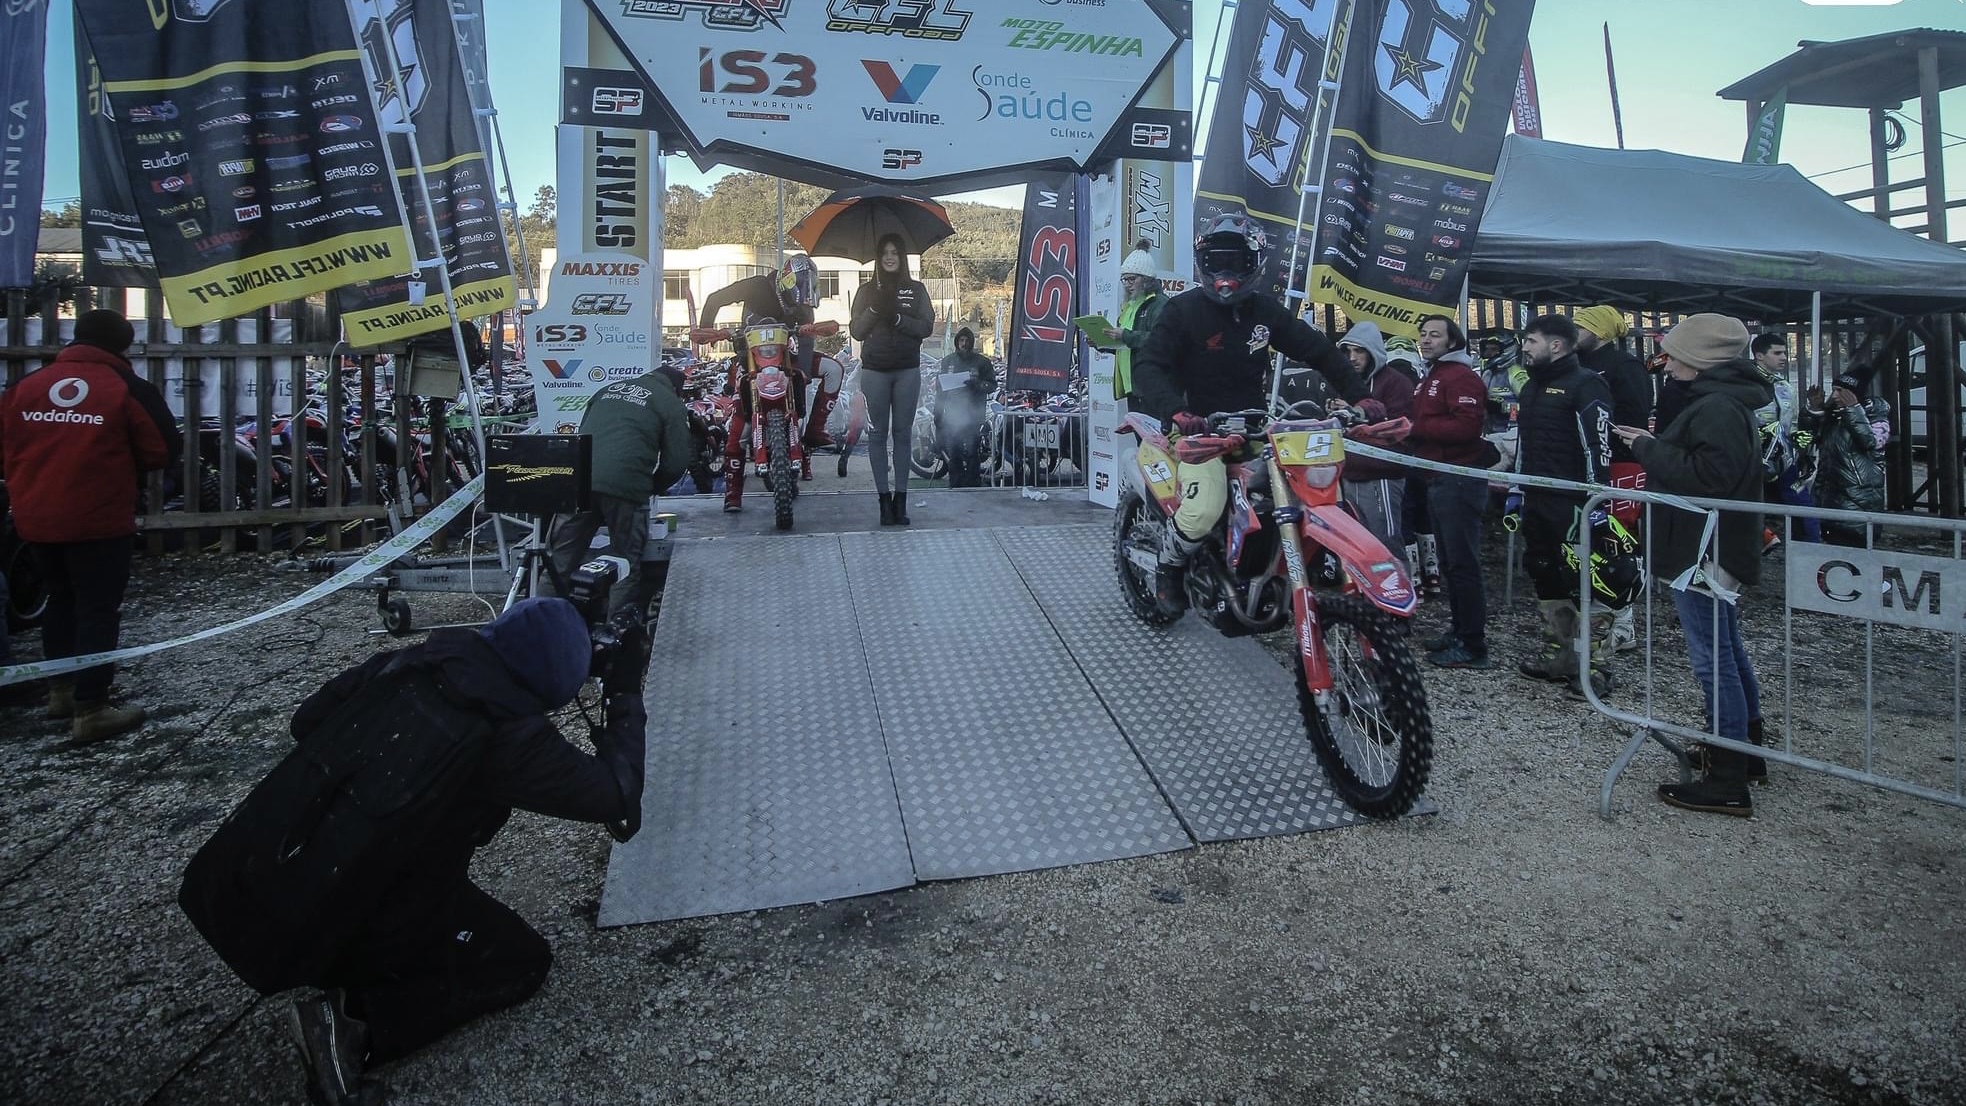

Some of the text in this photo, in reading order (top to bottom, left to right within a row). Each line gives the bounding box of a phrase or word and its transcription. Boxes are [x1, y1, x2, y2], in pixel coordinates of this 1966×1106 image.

[633, 1, 680, 14] 2023
[1000, 17, 1064, 31] MOTO
[1007, 30, 1143, 58] ESPINHA
[698, 47, 817, 98] IS3
[702, 97, 813, 111] METAL WORKING
[861, 106, 940, 125] Valvoline
[882, 149, 922, 170] SP
[595, 130, 637, 248] START
[562, 263, 640, 276] MAXXIS
[608, 278, 640, 287] TIRES
[1020, 225, 1077, 344] IS3
[535, 325, 588, 343] IS3
[609, 366, 644, 375] create
[22, 409, 104, 425] vodafone
